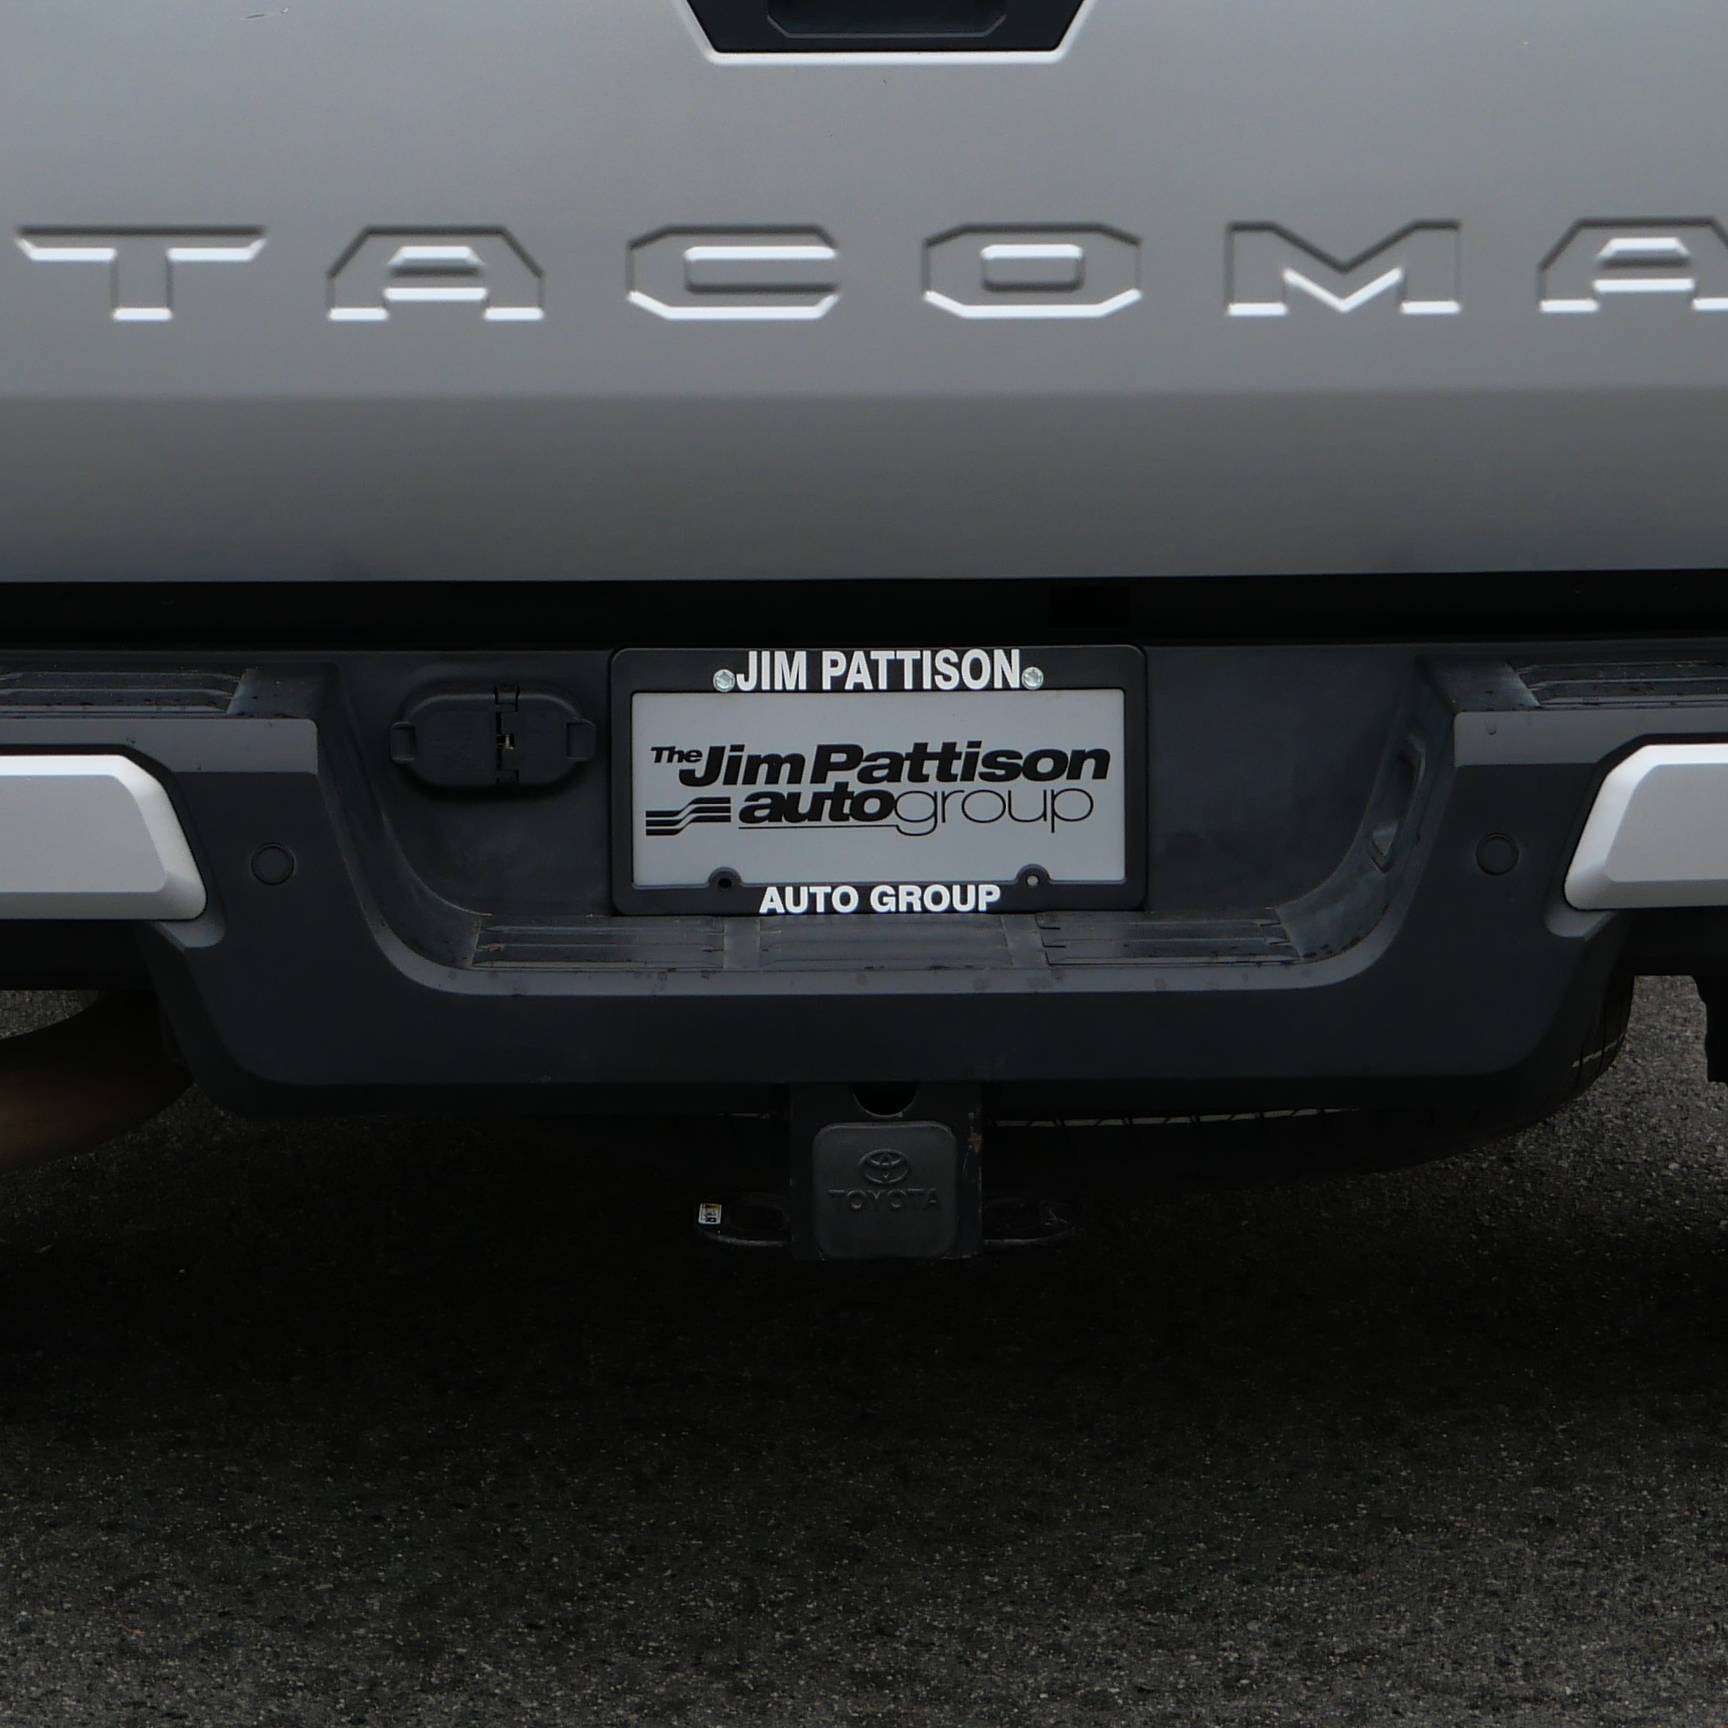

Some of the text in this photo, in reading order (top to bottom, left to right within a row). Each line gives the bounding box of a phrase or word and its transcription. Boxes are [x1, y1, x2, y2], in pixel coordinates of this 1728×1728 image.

[736, 648, 1020, 691] JIM PATTISON
[651, 745, 703, 764] The
[759, 884, 1001, 914] AUTO GROUP
[827, 1188, 941, 1211] TOYOTA
